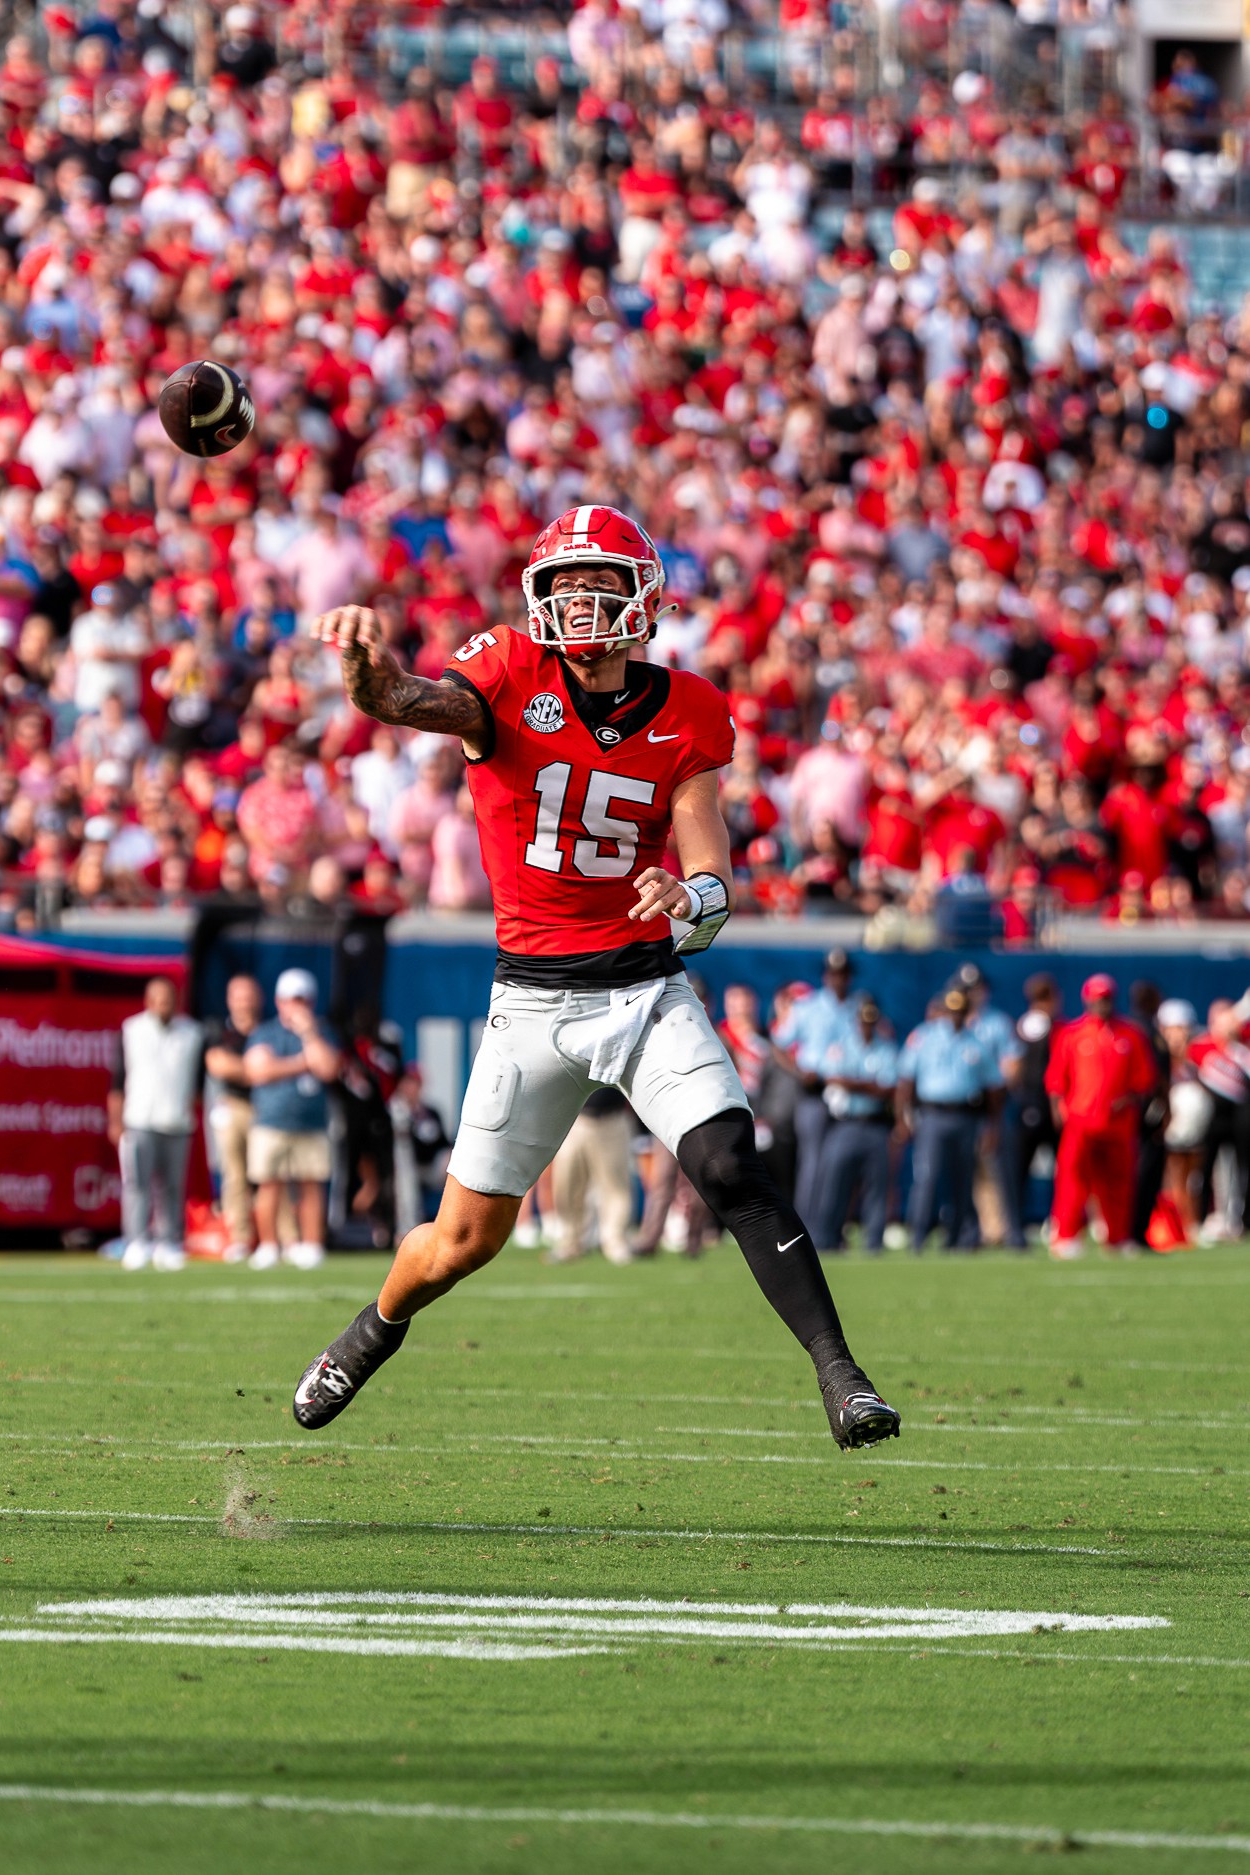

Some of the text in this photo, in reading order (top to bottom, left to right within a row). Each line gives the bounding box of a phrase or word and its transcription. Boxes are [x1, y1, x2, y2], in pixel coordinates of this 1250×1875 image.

[452, 631, 498, 662] 5
[525, 714, 559, 733] GRADUATE
[531, 694, 562, 724] SEC
[524, 760, 658, 878] 15
